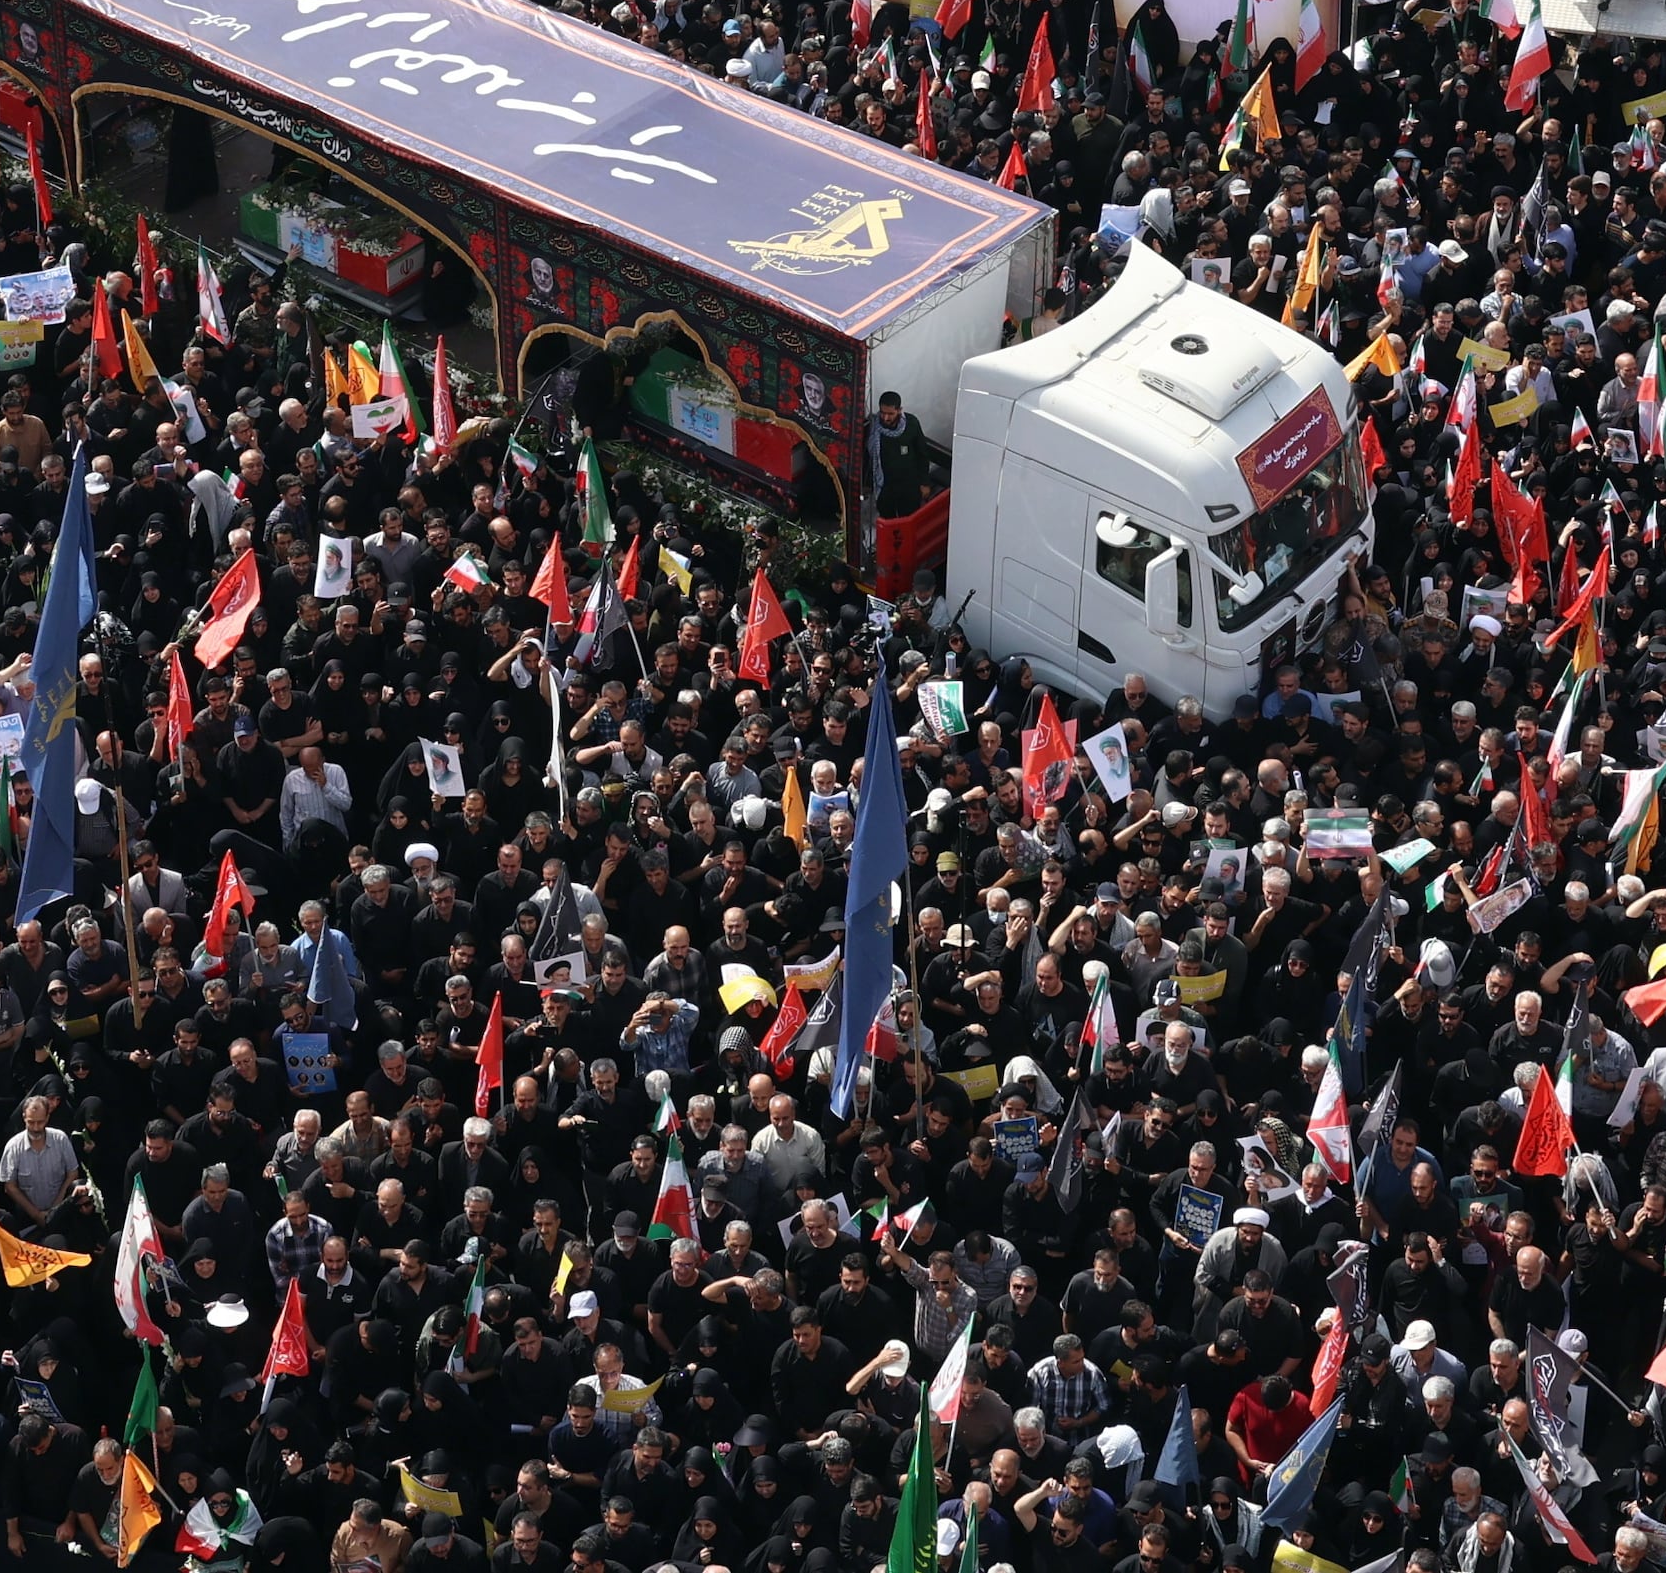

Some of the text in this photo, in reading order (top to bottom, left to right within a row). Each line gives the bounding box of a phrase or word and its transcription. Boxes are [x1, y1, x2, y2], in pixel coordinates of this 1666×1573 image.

[192, 77, 232, 106] است
[232, 92, 276, 126] پیروز
[291, 123, 333, 143] حسین
[321, 136, 351, 163] ایران
[1312, 413, 1322, 424] سپاه
[1284, 444, 1308, 469] تهران بزرگ
